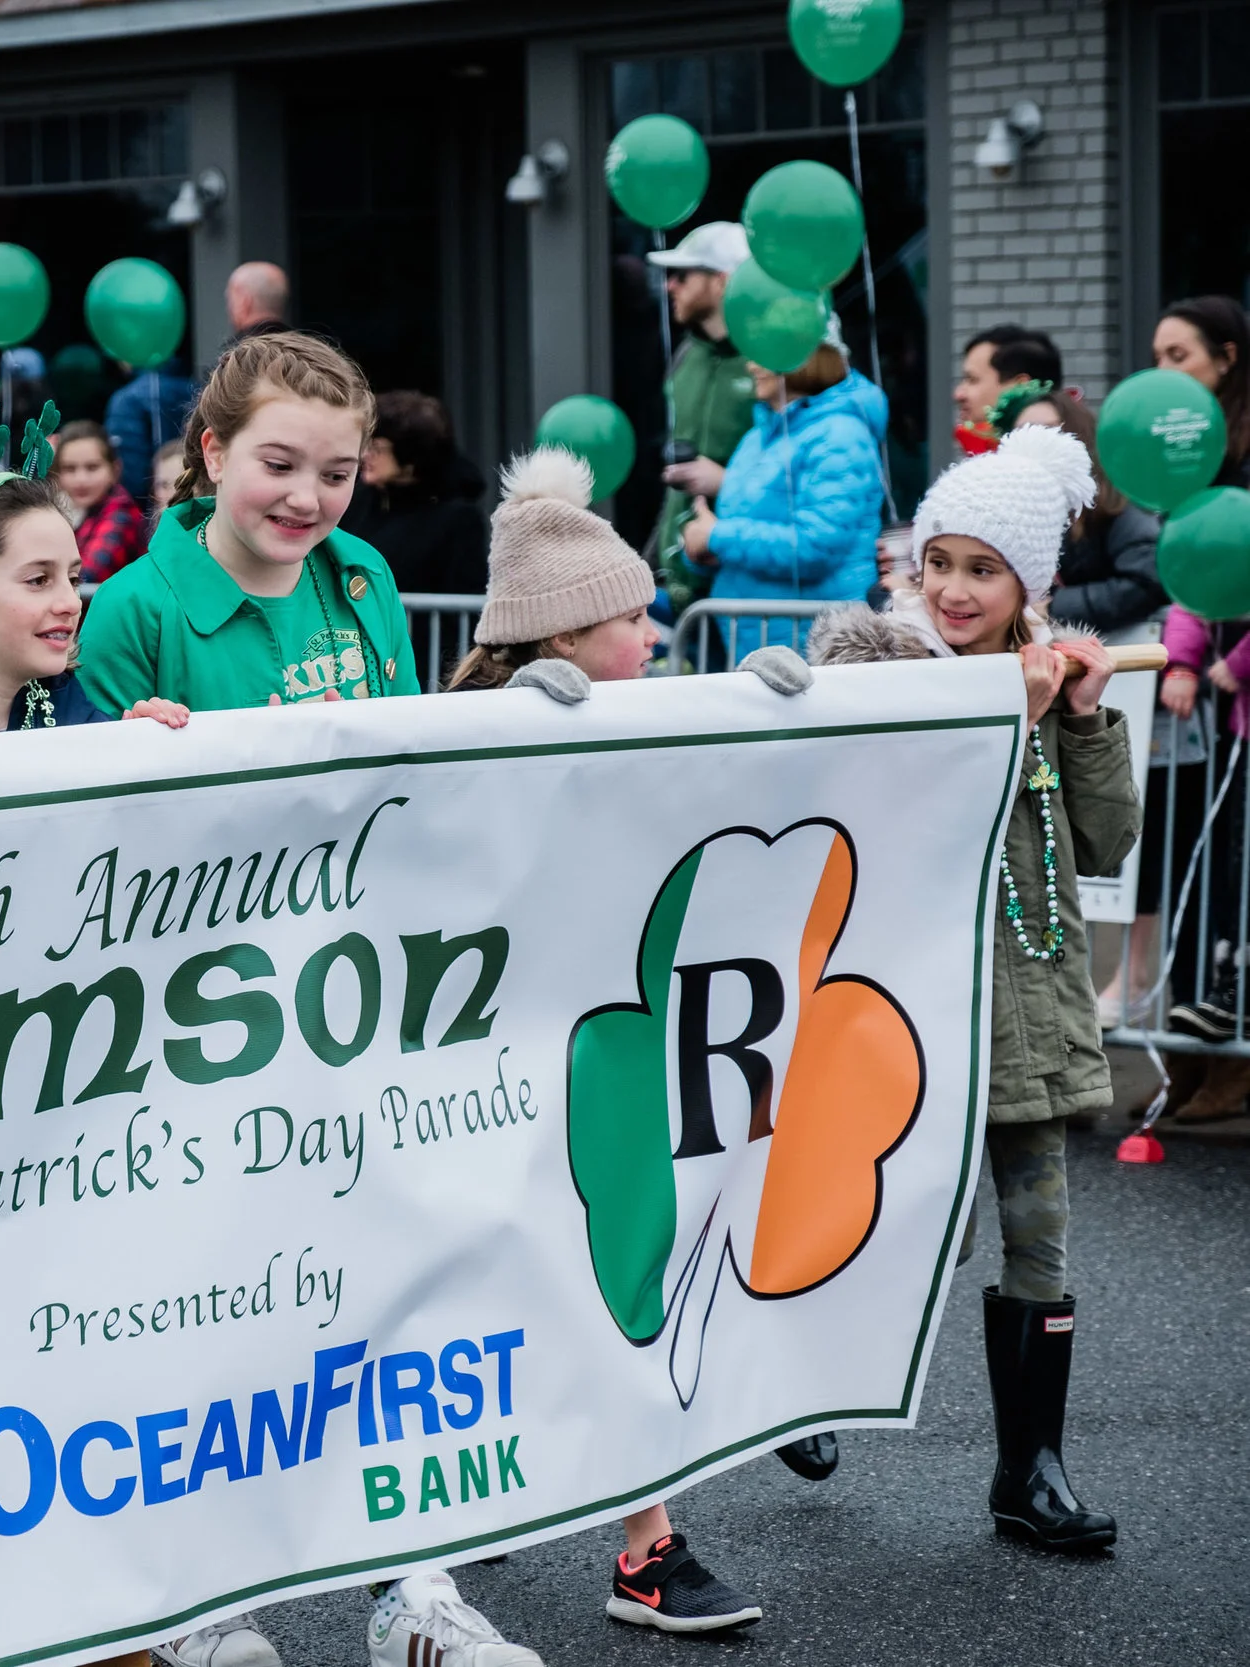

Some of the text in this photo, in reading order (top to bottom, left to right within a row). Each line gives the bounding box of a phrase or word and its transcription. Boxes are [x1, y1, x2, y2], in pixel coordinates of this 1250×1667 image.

[45, 797, 411, 962] Annual
[234, 1106, 364, 1199] Day
[380, 1046, 539, 1151] Parade
[672, 957, 785, 1160] R
[29, 1246, 343, 1353] Presented by
[362, 1435, 527, 1524] BANK
